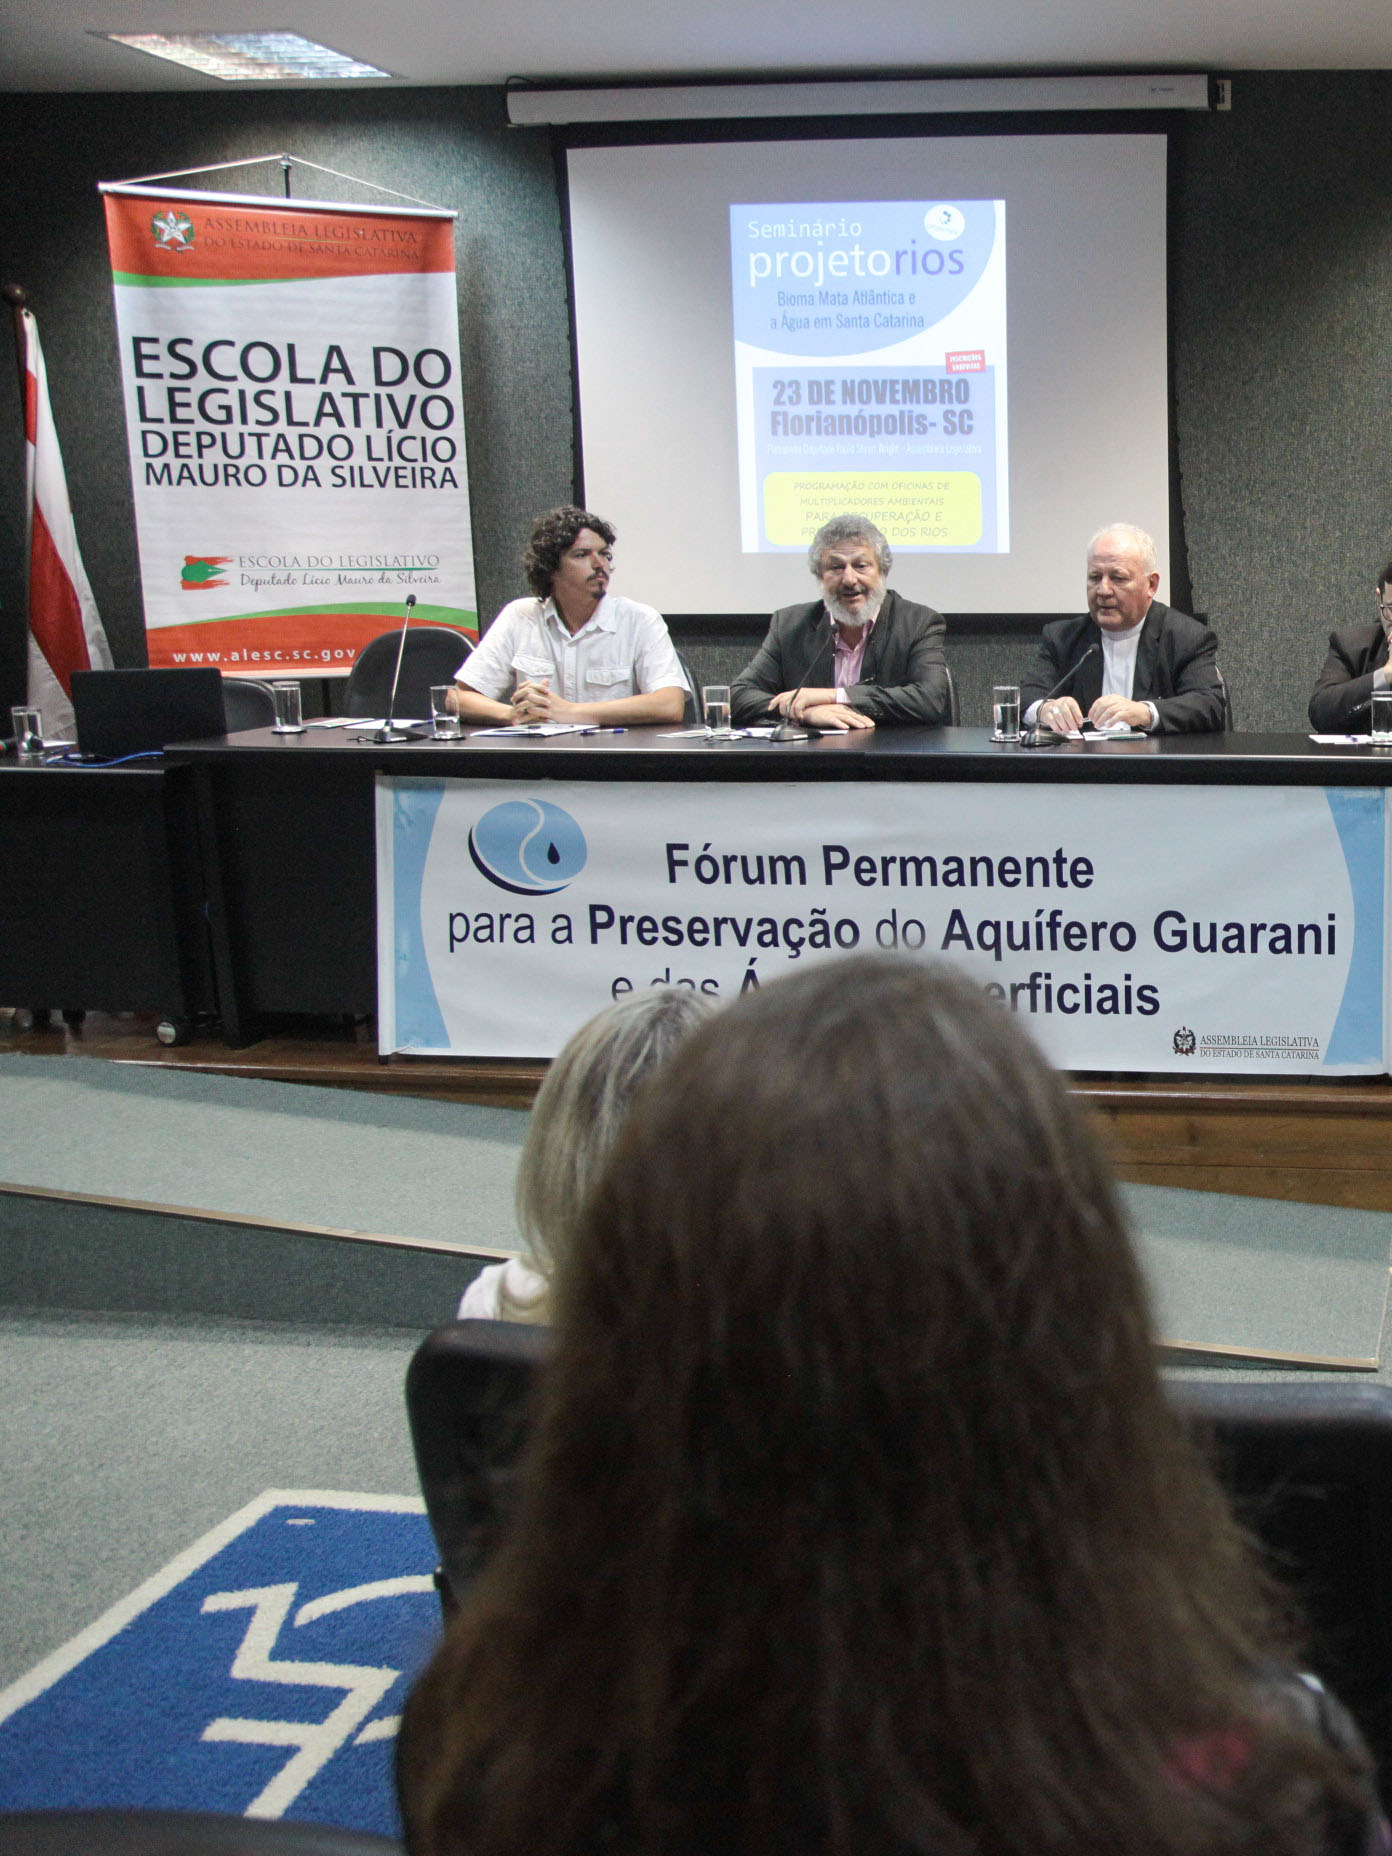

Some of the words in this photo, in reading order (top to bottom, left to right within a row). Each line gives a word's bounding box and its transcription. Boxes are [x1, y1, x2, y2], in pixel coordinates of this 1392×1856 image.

[204, 217, 309, 236] ASSEMBLEIA
[315, 225, 417, 243] LEGISLATIVA
[747, 218, 862, 239] Seminário
[204, 237, 226, 248] DO
[231, 238, 282, 250] ESTADO
[310, 243, 351, 256] SANTA
[354, 246, 420, 260] CATARINA
[749, 239, 965, 287] projetorios
[777, 291, 815, 306] Bioma
[818, 290, 848, 306] Mata
[852, 289, 906, 305] Atlântica
[908, 294, 916, 305] e
[770, 319, 777, 329] a
[781, 312, 810, 332] Água
[814, 318, 832, 329] em
[836, 312, 870, 328] Santa
[874, 311, 924, 328] Catarina
[132, 336, 356, 385] ESCOLA
[372, 346, 452, 389] DO
[772, 379, 805, 406] 23
[807, 379, 835, 406] DE
[841, 378, 970, 405] NOVEMBRO
[137, 385, 455, 430] LEGISLATIVO
[943, 409, 974, 435] SC
[141, 430, 354, 461] DEPUTADO
[366, 429, 457, 463] LÍCIO
[145, 463, 267, 488] MAURO
[278, 464, 322, 488] DA
[332, 465, 459, 489] SILVEIRA
[793, 480, 865, 492] PROGRAMAÇÃO
[868, 481, 889, 490] COM
[891, 481, 935, 490] OFICINAS
[937, 481, 950, 490] DE
[800, 497, 884, 506] MULTIPLICADORES
[887, 496, 945, 506] AMBIENTAIS
[935, 511, 943, 521] E
[891, 527, 916, 537] DOS
[920, 527, 949, 537] RIOS
[238, 555, 301, 568] ESCOLA
[308, 555, 333, 568] DO
[340, 554, 440, 567] LEGISLATIVO
[240, 572, 298, 592] Deputado
[335, 572, 374, 586] Mauro
[378, 571, 393, 584] da
[396, 571, 440, 585] Silveira
[173, 648, 356, 663] www.alesc.sc.gov
[666, 842, 807, 886] Fórum
[823, 844, 1095, 889] Permanente
[448, 910, 536, 953] para
[551, 913, 573, 944] a
[588, 903, 861, 958] Preservação
[875, 908, 926, 951] do
[941, 908, 1137, 961] Aquífero
[1153, 910, 1337, 956] Guarani
[611, 977, 634, 1001] e
[984, 971, 1161, 1016] erficiais
[1200, 1034, 1258, 1046] ASSEMBLEIA
[1260, 1036, 1320, 1048] LEGISLATIVA
[1200, 1050, 1211, 1058] DO
[1213, 1050, 1242, 1058] ESTADO
[1244, 1050, 1254, 1058] DE
[1255, 1050, 1280, 1059] SANTA
[1281, 1051, 1320, 1060] CATARINA
